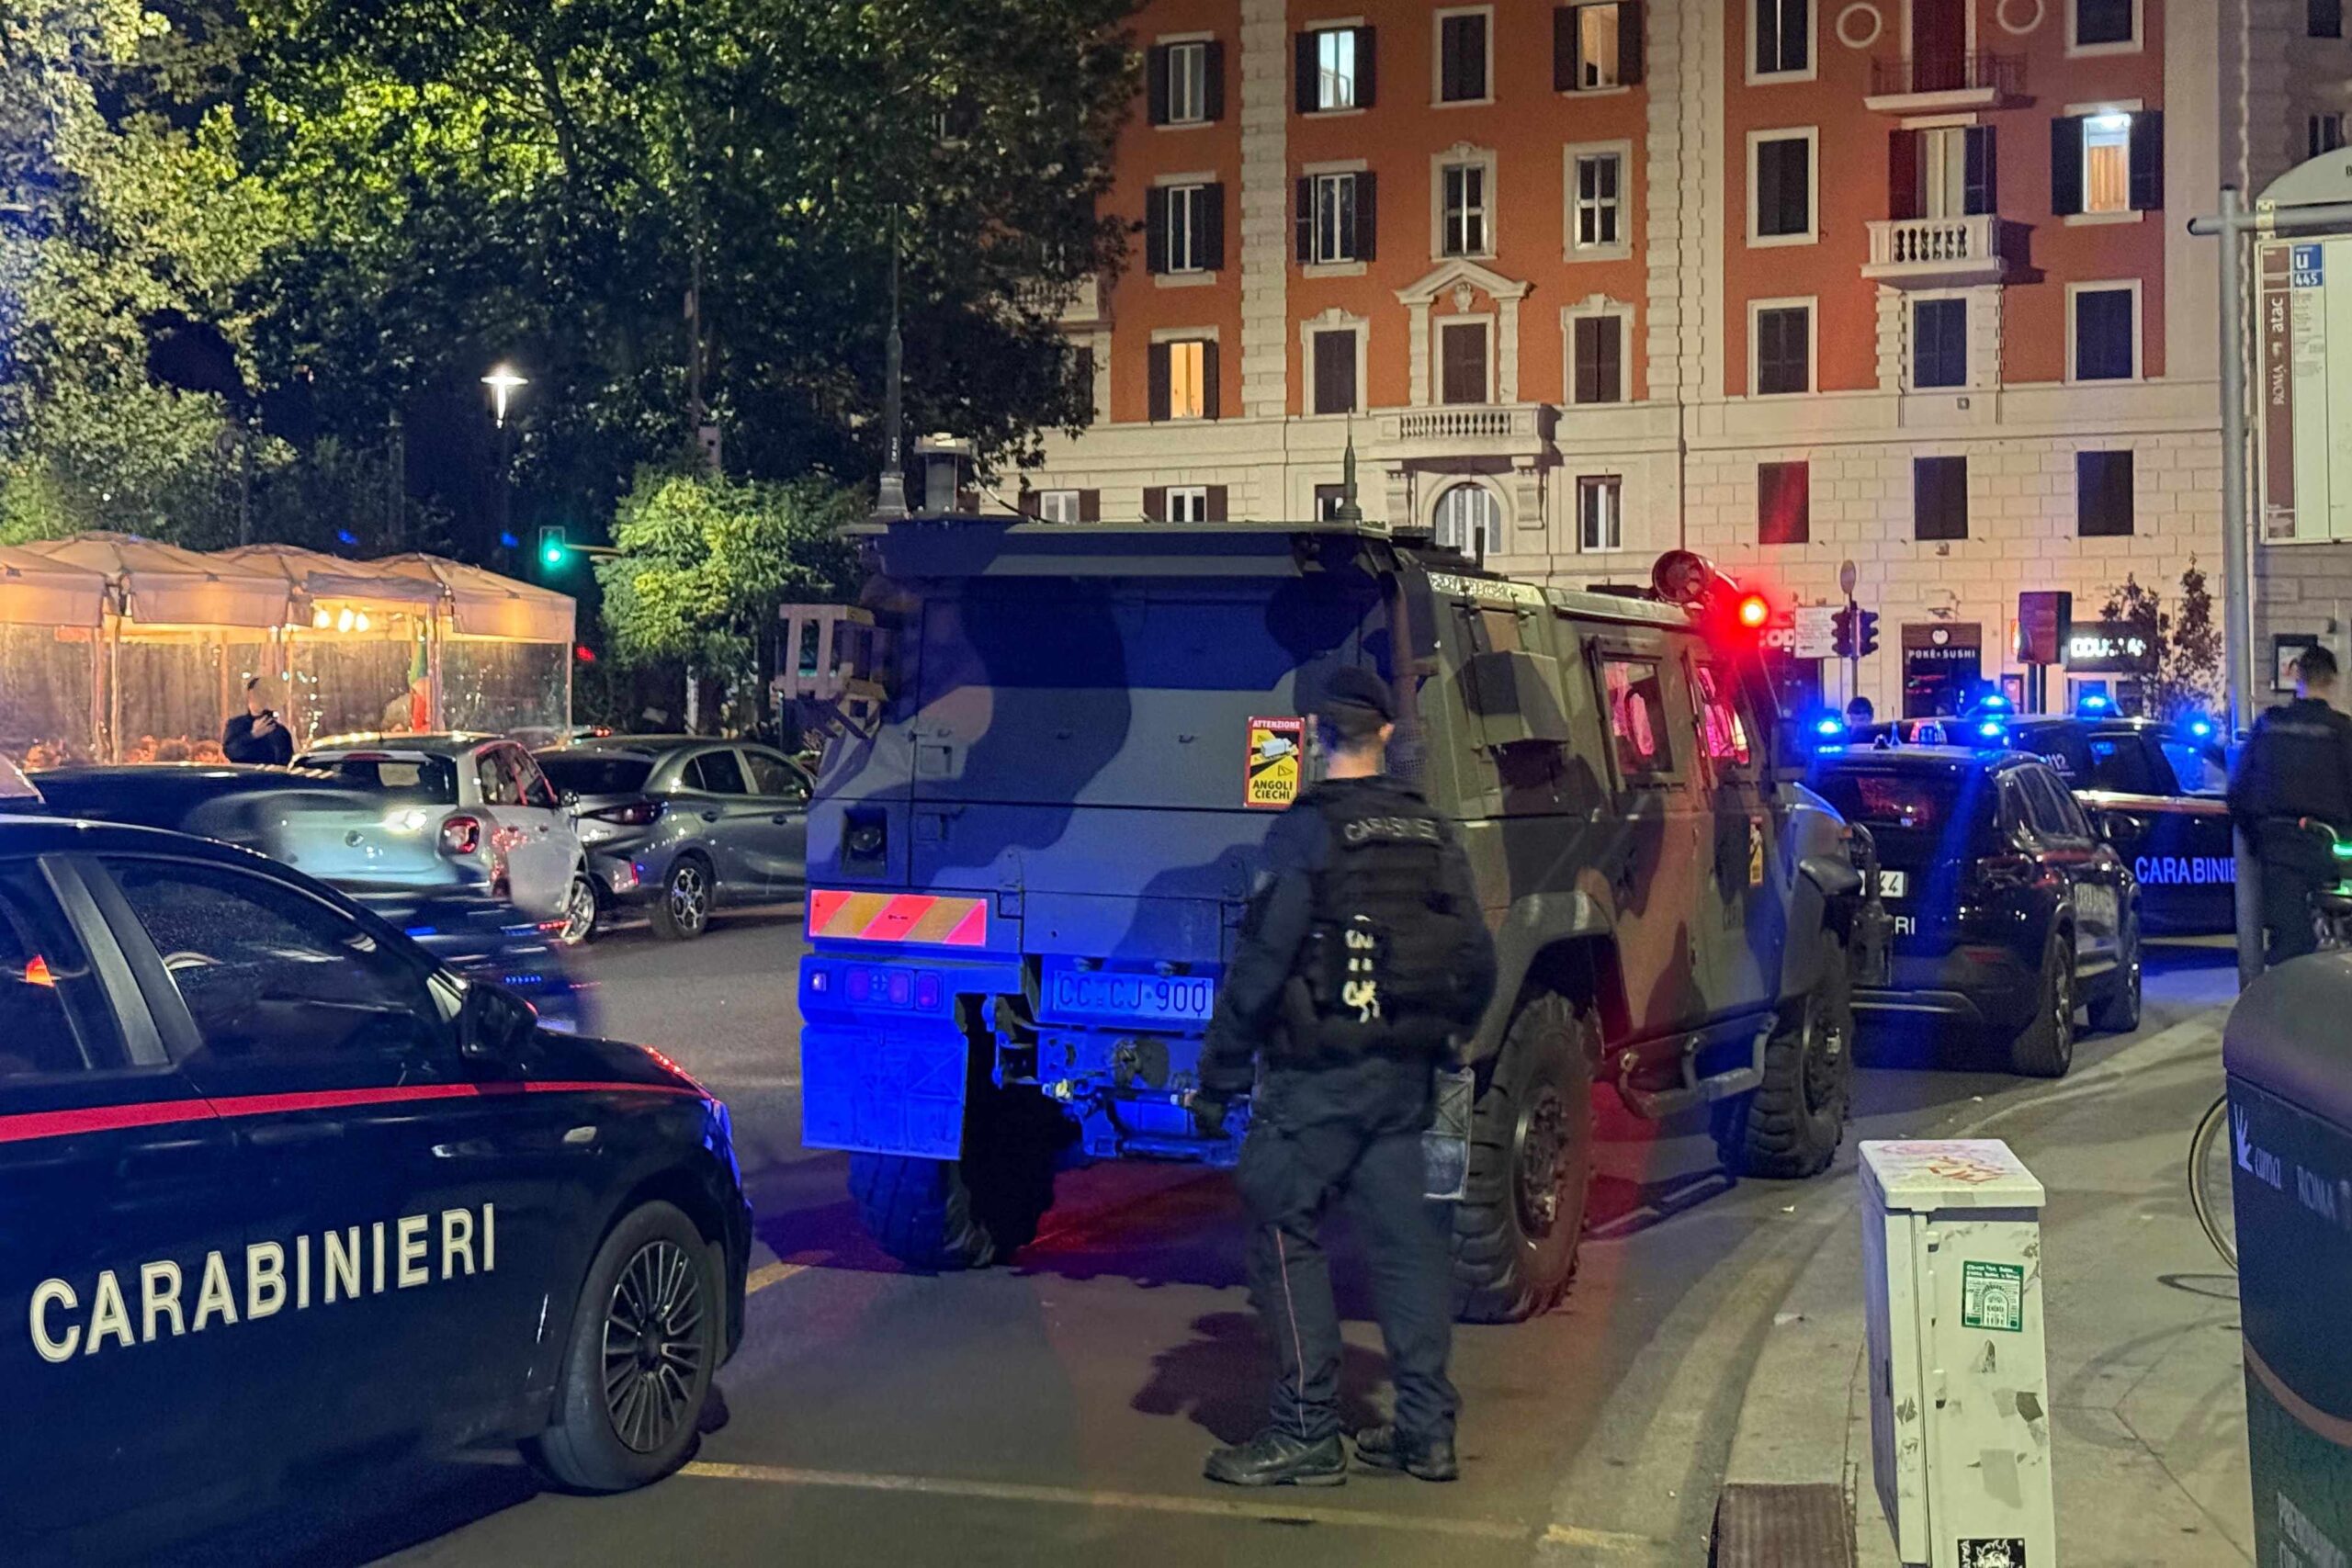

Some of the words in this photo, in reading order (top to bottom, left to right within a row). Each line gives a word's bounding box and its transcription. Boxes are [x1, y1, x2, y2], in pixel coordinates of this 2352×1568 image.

[2295, 272, 2318, 286] 445
[2271, 298, 2284, 333] atac
[1252, 720, 1300, 729] ATTENZIONE
[1252, 780, 1293, 791] ANGOLI
[1254, 790, 1290, 799] CIECHI
[30, 1202, 493, 1363] CARABINIERI
